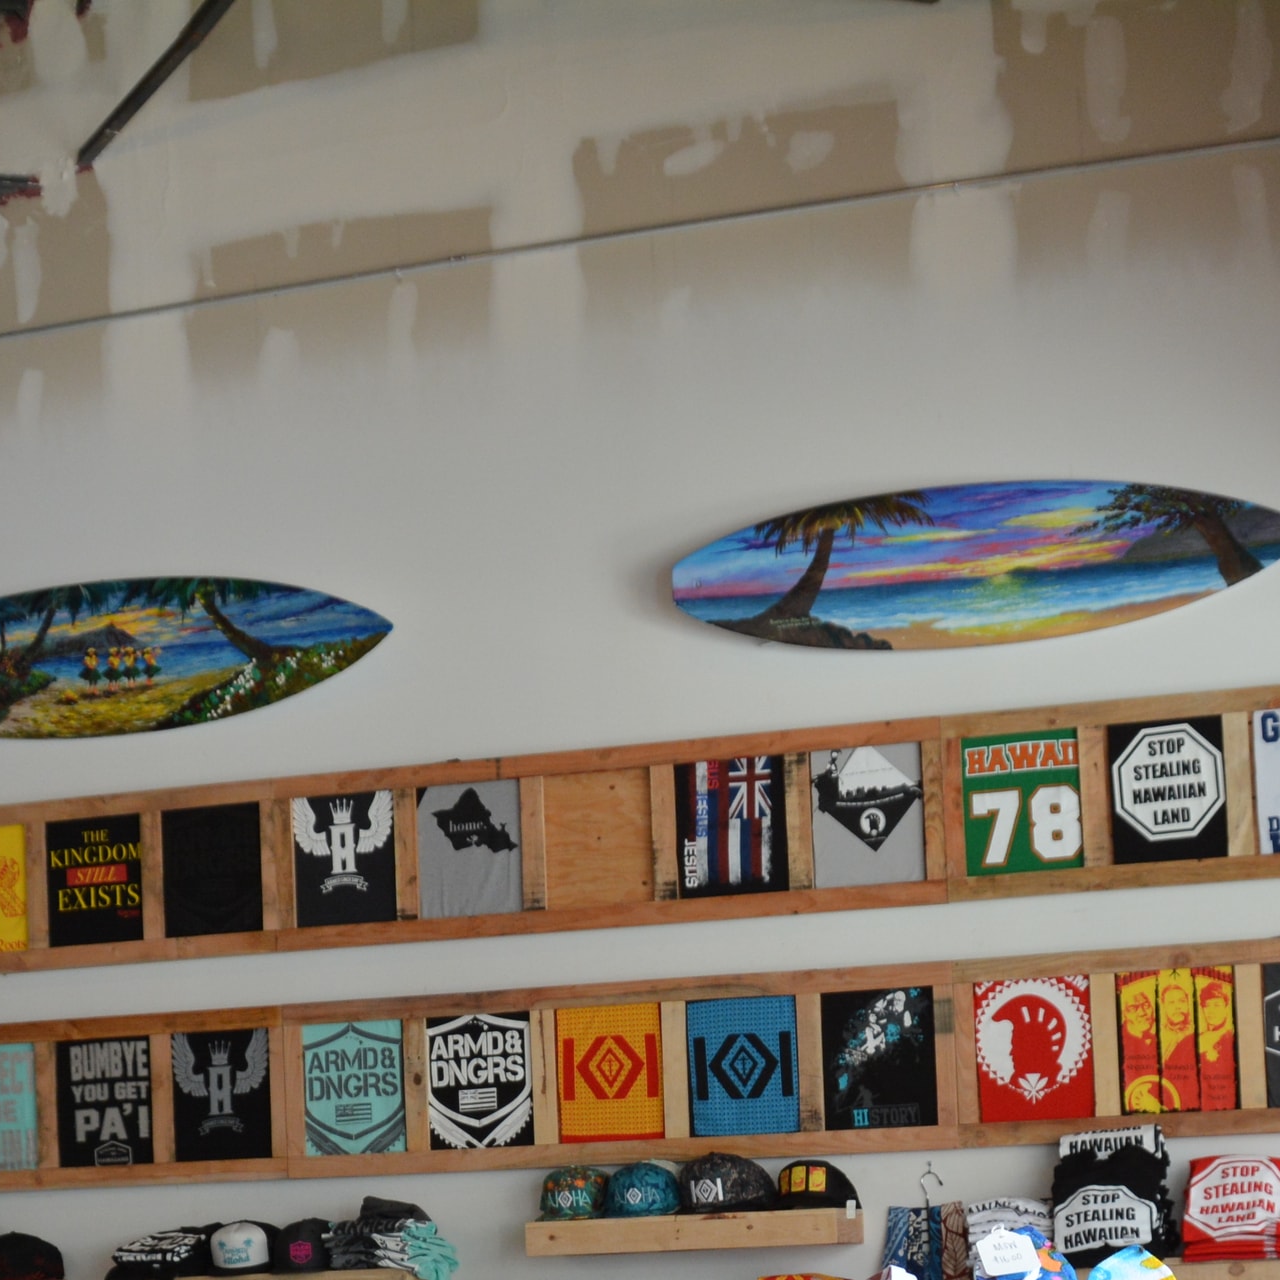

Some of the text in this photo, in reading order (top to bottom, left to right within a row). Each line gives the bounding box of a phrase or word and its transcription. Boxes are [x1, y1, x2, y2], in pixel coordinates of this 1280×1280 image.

[1147, 737, 1186, 757] STOP
[1133, 759, 1202, 782] STEALING
[1132, 781, 1207, 805] HAWAIIAN
[449, 818, 488, 834] home.
[970, 784, 1083, 868] 78
[1153, 806, 1192, 826] LAND
[81, 829, 110, 844] THE
[50, 842, 142, 868] KINGDOM
[684, 838, 699, 888] JESUS
[73, 865, 120, 883] STILL
[57, 884, 141, 912] EXISTS
[70, 1040, 148, 1081] BUMBYE
[431, 1054, 525, 1088] DNGRS
[72, 1081, 149, 1103] YOU GET
[308, 1071, 399, 1101] DNGRS
[1221, 1165, 1261, 1179] STOP
[1081, 1192, 1121, 1206] STOP
[1203, 1181, 1274, 1201] STEALING
[1064, 1206, 1137, 1228] STEALING
[1199, 1198, 1276, 1217] HAWAIIAN
[1217, 1211, 1257, 1224] LAND
[1063, 1224, 1140, 1250] HAWAIIAN
